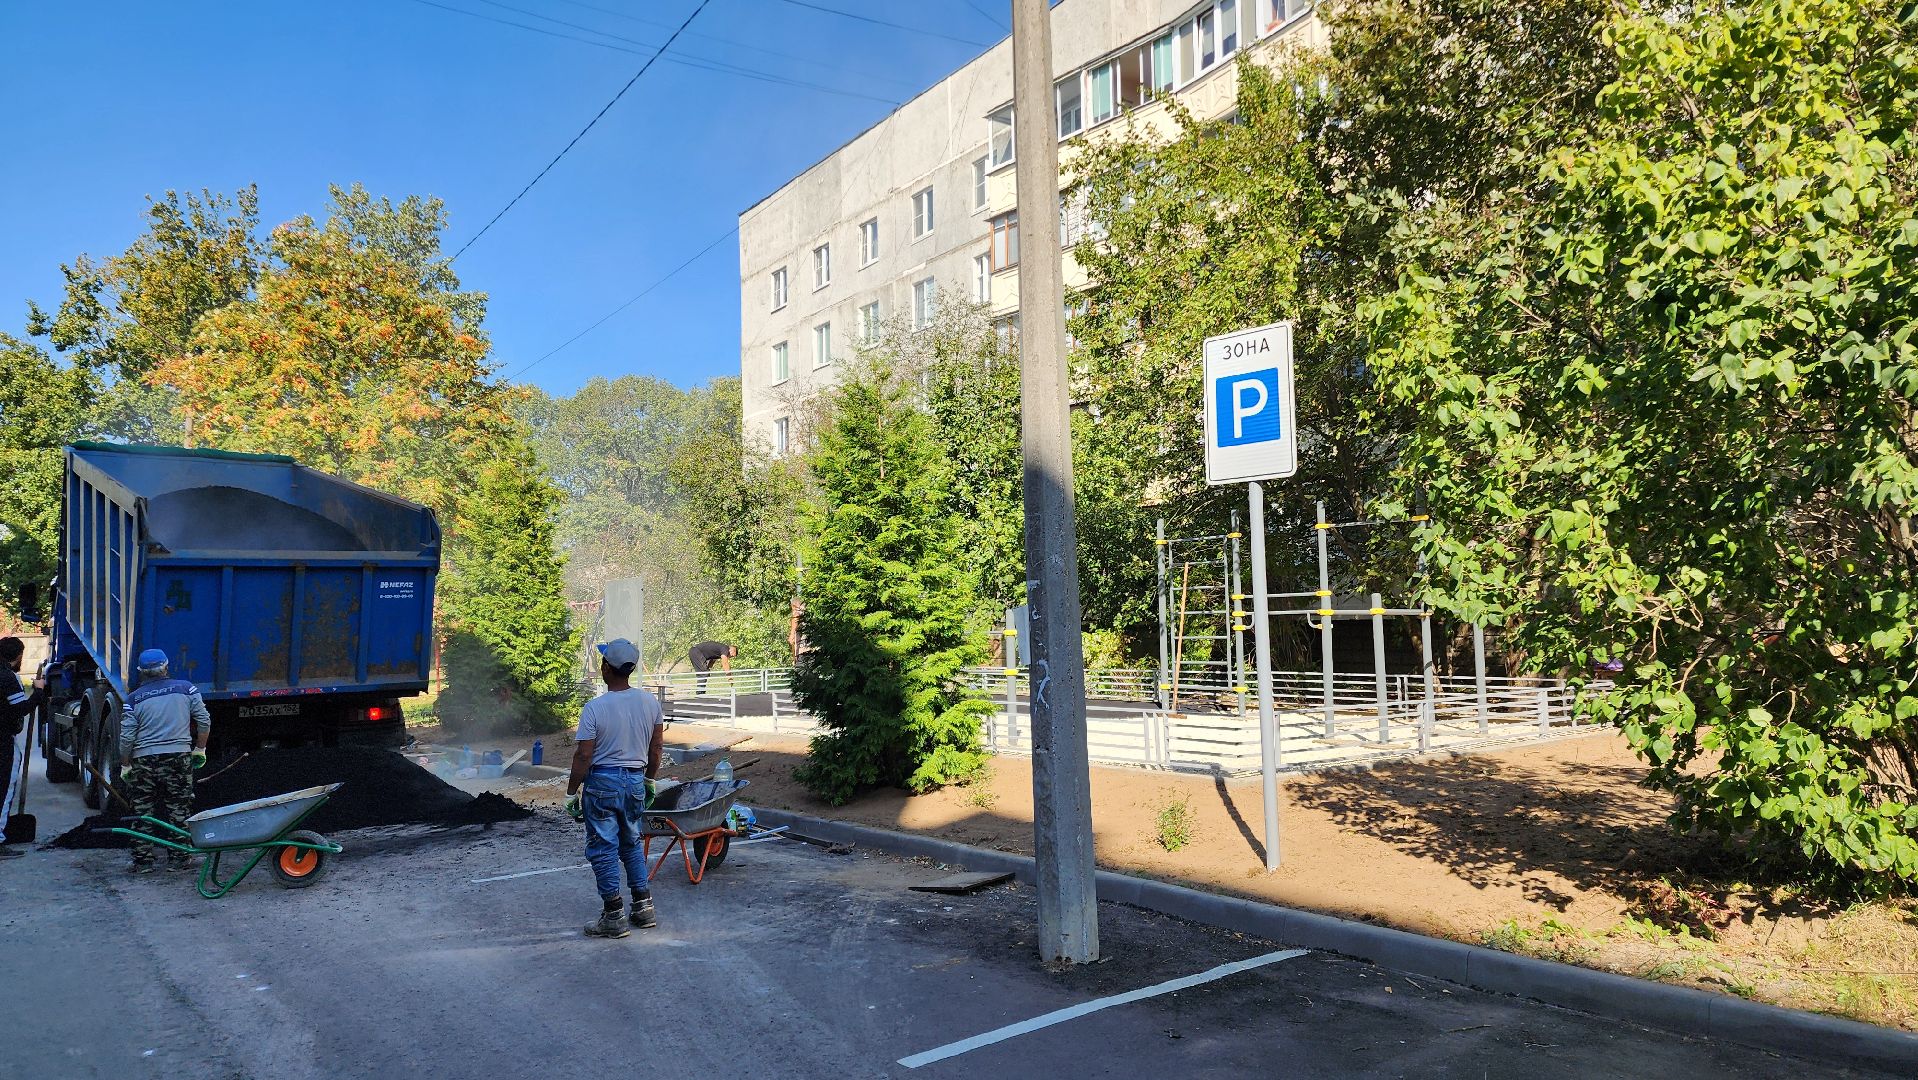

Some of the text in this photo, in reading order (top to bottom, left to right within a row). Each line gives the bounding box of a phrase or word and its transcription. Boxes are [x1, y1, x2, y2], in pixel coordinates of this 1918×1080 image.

[1222, 337, 1270, 361] ЗОНА
[1232, 378, 1269, 439] P
[134, 685, 176, 702] SPORT
